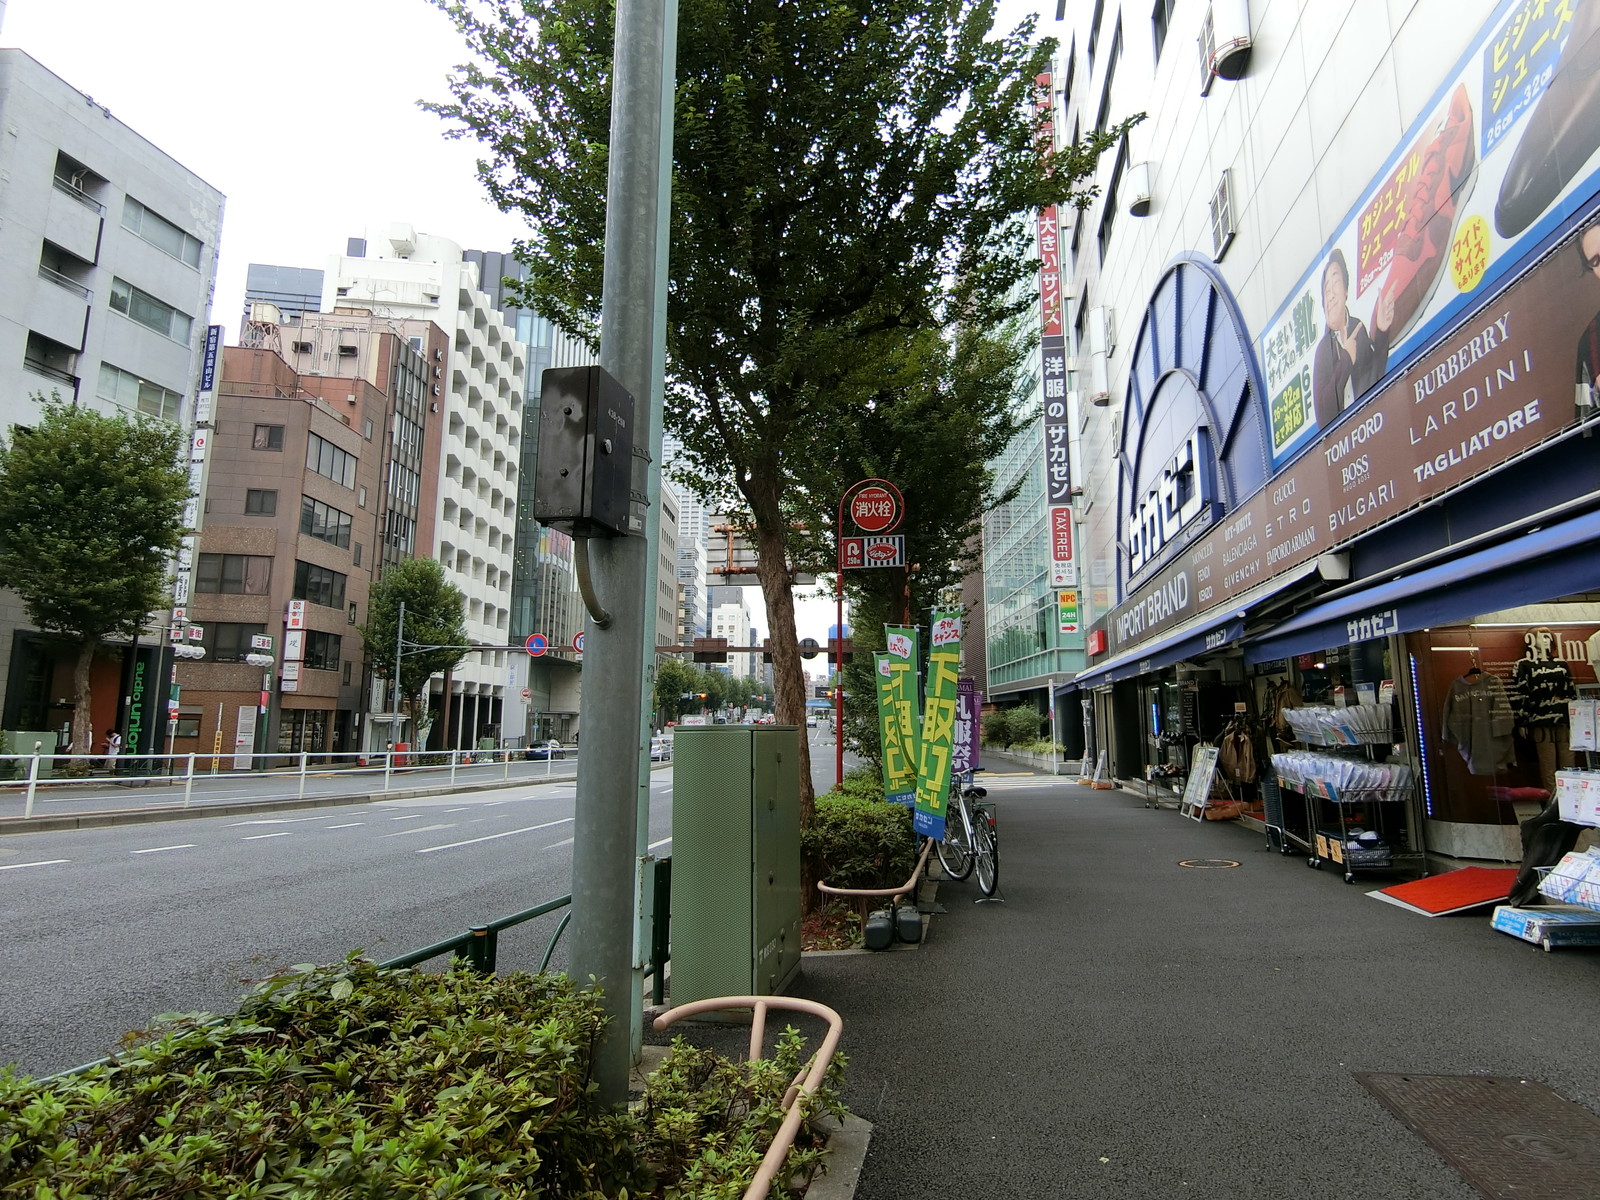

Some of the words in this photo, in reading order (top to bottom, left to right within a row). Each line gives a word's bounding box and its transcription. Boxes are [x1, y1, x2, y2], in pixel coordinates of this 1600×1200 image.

[1362, 152, 1420, 240] カジュアル
[1361, 193, 1407, 269] シューズ
[1453, 218, 1481, 257] ワイド
[1040, 217, 1060, 325] 大きいサイズ
[1455, 236, 1484, 275] サイズ
[1458, 257, 1486, 289] もあります
[1292, 290, 1316, 357] 靴
[1266, 321, 1293, 367] 大きい
[1413, 311, 1511, 404] BURBERRY
[1268, 349, 1296, 389] サイズの
[1409, 349, 1531, 445] LARDINI
[1324, 436, 1349, 467] TOM
[1351, 412, 1383, 449] FORD
[1413, 398, 1541, 483] TAGLIATORE
[1341, 453, 1369, 486] BOSS
[1343, 481, 1357, 493] HUGO
[1357, 472, 1370, 485] BOSS
[855, 500, 891, 517] 消火栓
[1129, 430, 1204, 575] サカゼン
[1273, 477, 1296, 505] GUCCI
[1328, 479, 1395, 532] BVLGARI
[1056, 511, 1067, 530] TAX
[1265, 498, 1310, 538] ETRO
[1056, 532, 1068, 558] FREE
[1222, 533, 1258, 567] BALENCIAGA
[1266, 539, 1291, 566] EMPORIO
[1291, 525, 1316, 550] ARMANI
[1197, 564, 1211, 584] FENDI
[1224, 558, 1260, 589] GIVENCHY
[1060, 594, 1076, 603] NPC
[1116, 598, 1146, 644] IMPORT
[1147, 571, 1188, 627] BRAND
[1198, 585, 1213, 603] KENZO
[934, 629, 960, 644] チャンス
[1347, 609, 1399, 642] サカゼン
[133, 662, 144, 701] audio
[127, 703, 142, 755] union
[920, 652, 959, 792] 下取り
[916, 786, 940, 810] セール
